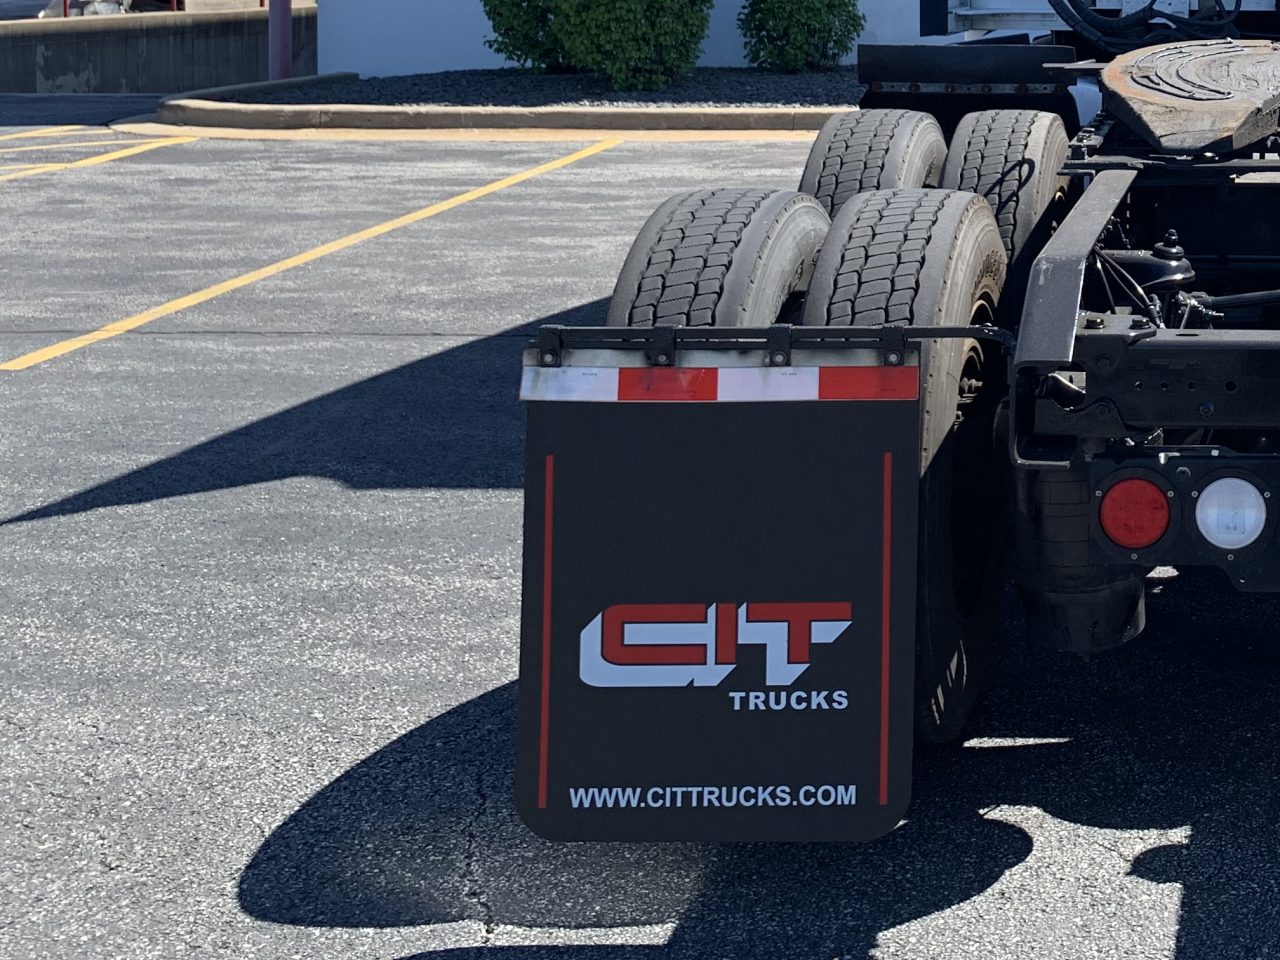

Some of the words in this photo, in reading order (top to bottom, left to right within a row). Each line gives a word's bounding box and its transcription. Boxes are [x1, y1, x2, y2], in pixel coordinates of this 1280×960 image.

[579, 601, 853, 688] CIT
[728, 690, 849, 711] TRUCKS
[569, 784, 857, 809] WWW.CITTRUCKS.COM
